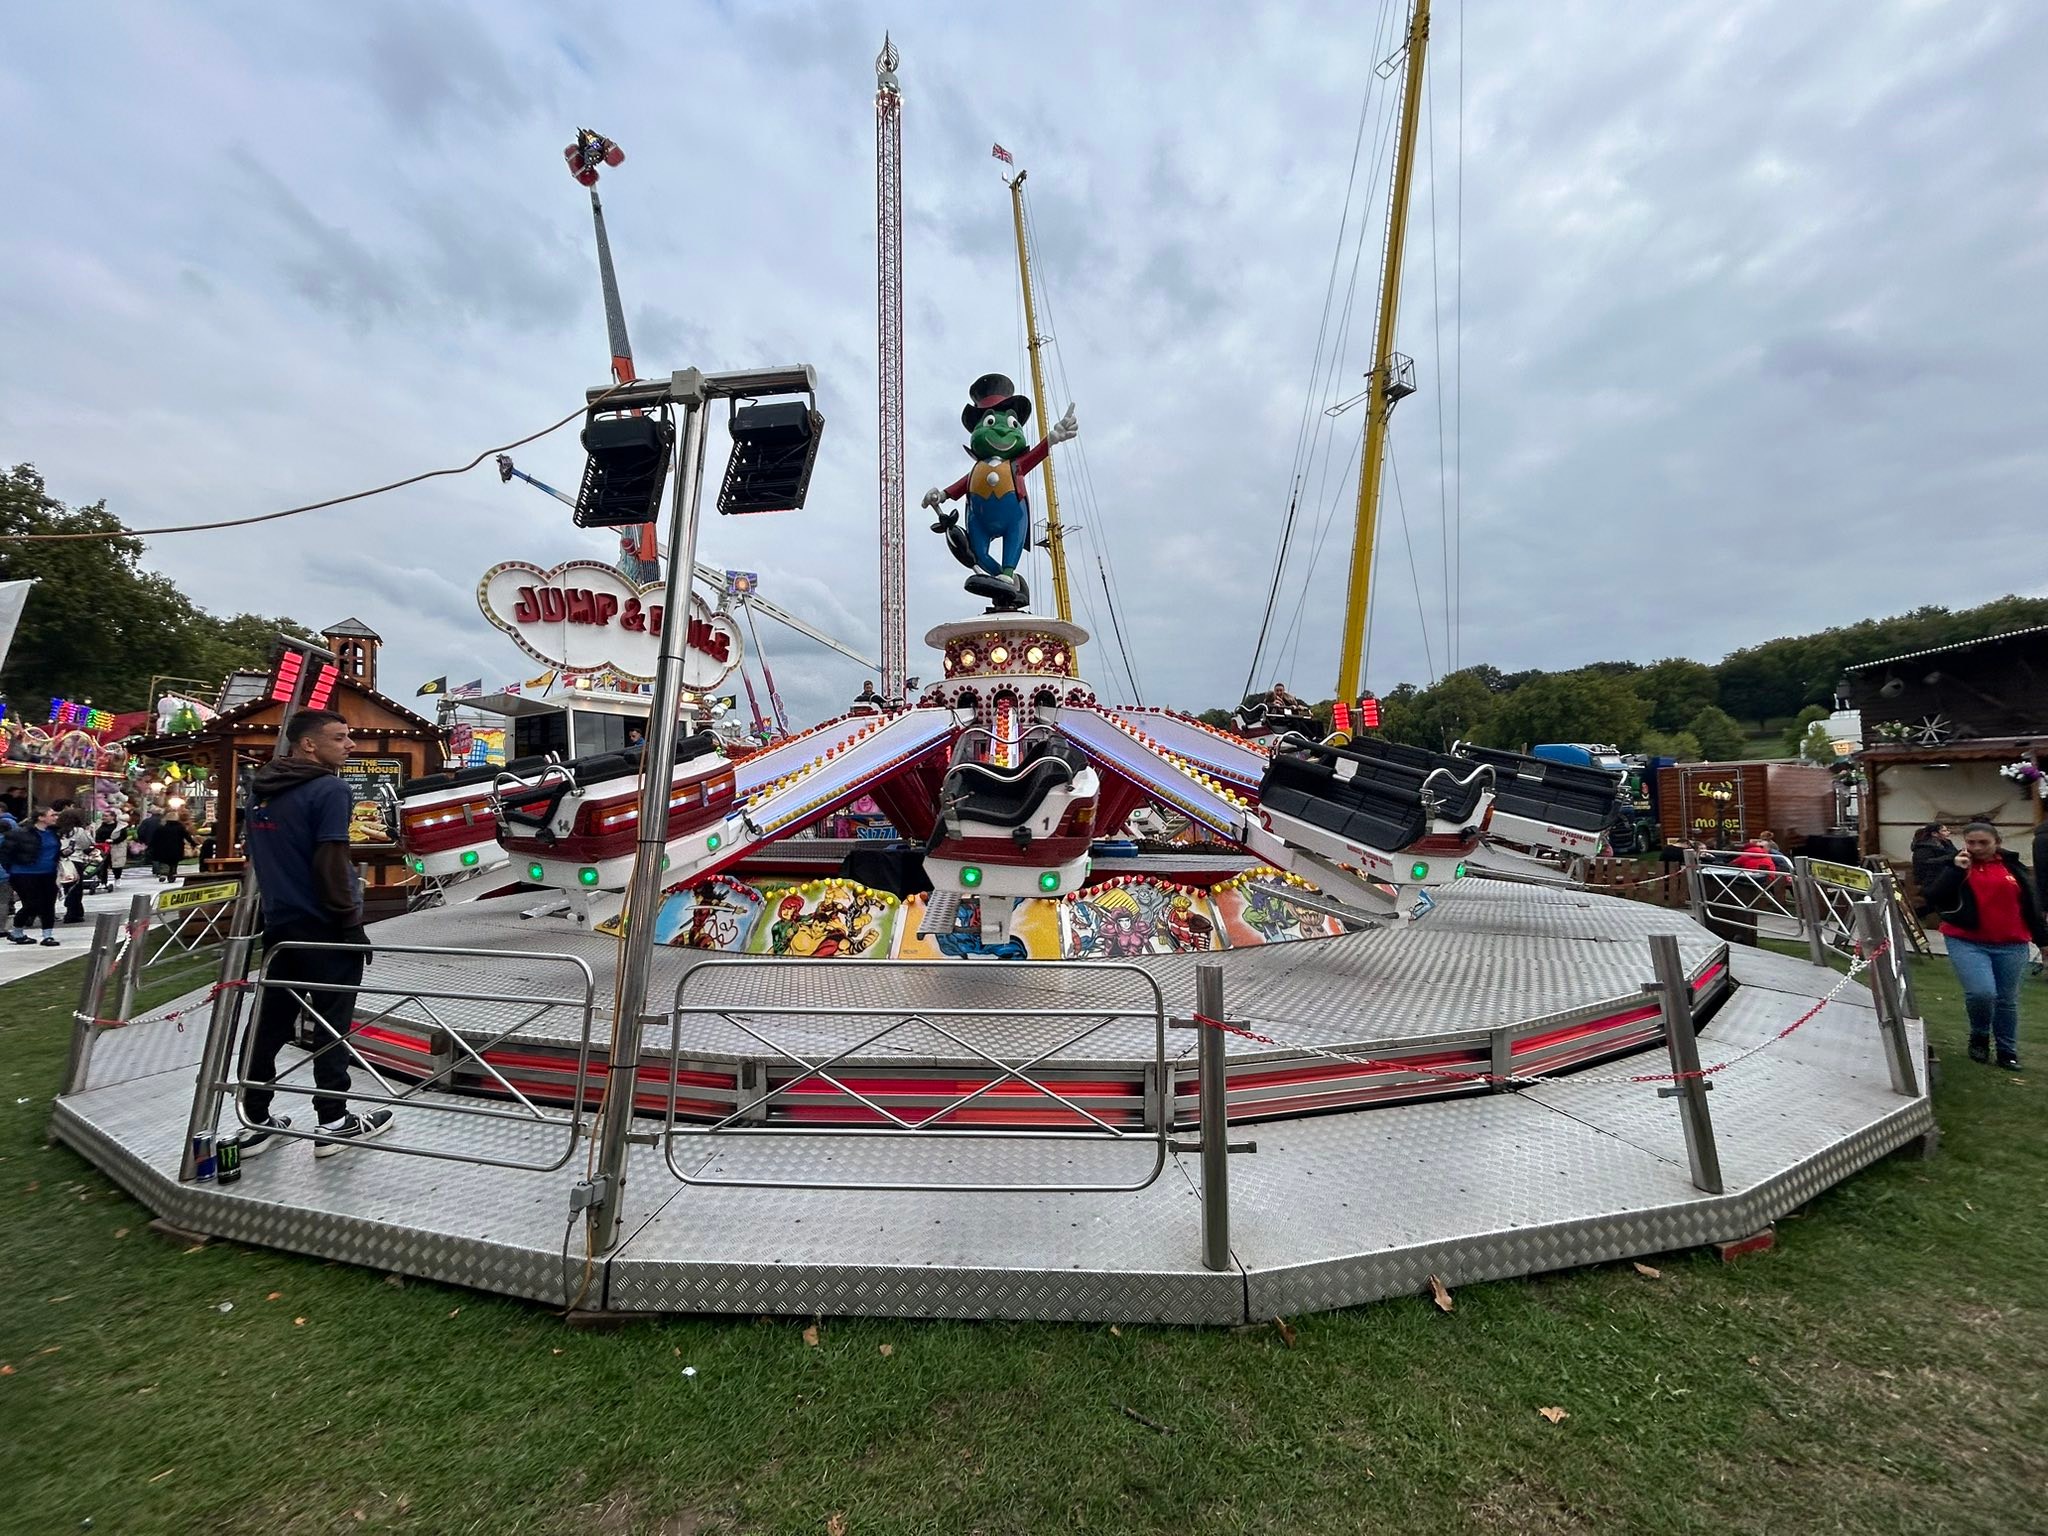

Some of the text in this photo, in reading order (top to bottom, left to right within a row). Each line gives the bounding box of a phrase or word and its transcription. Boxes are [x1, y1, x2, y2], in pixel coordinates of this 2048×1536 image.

[514, 586, 730, 663] JUMP & ILE
[367, 766, 400, 774] HOUSE
[1042, 817, 1050, 831] 1
[1694, 818, 1740, 829] MOSE
